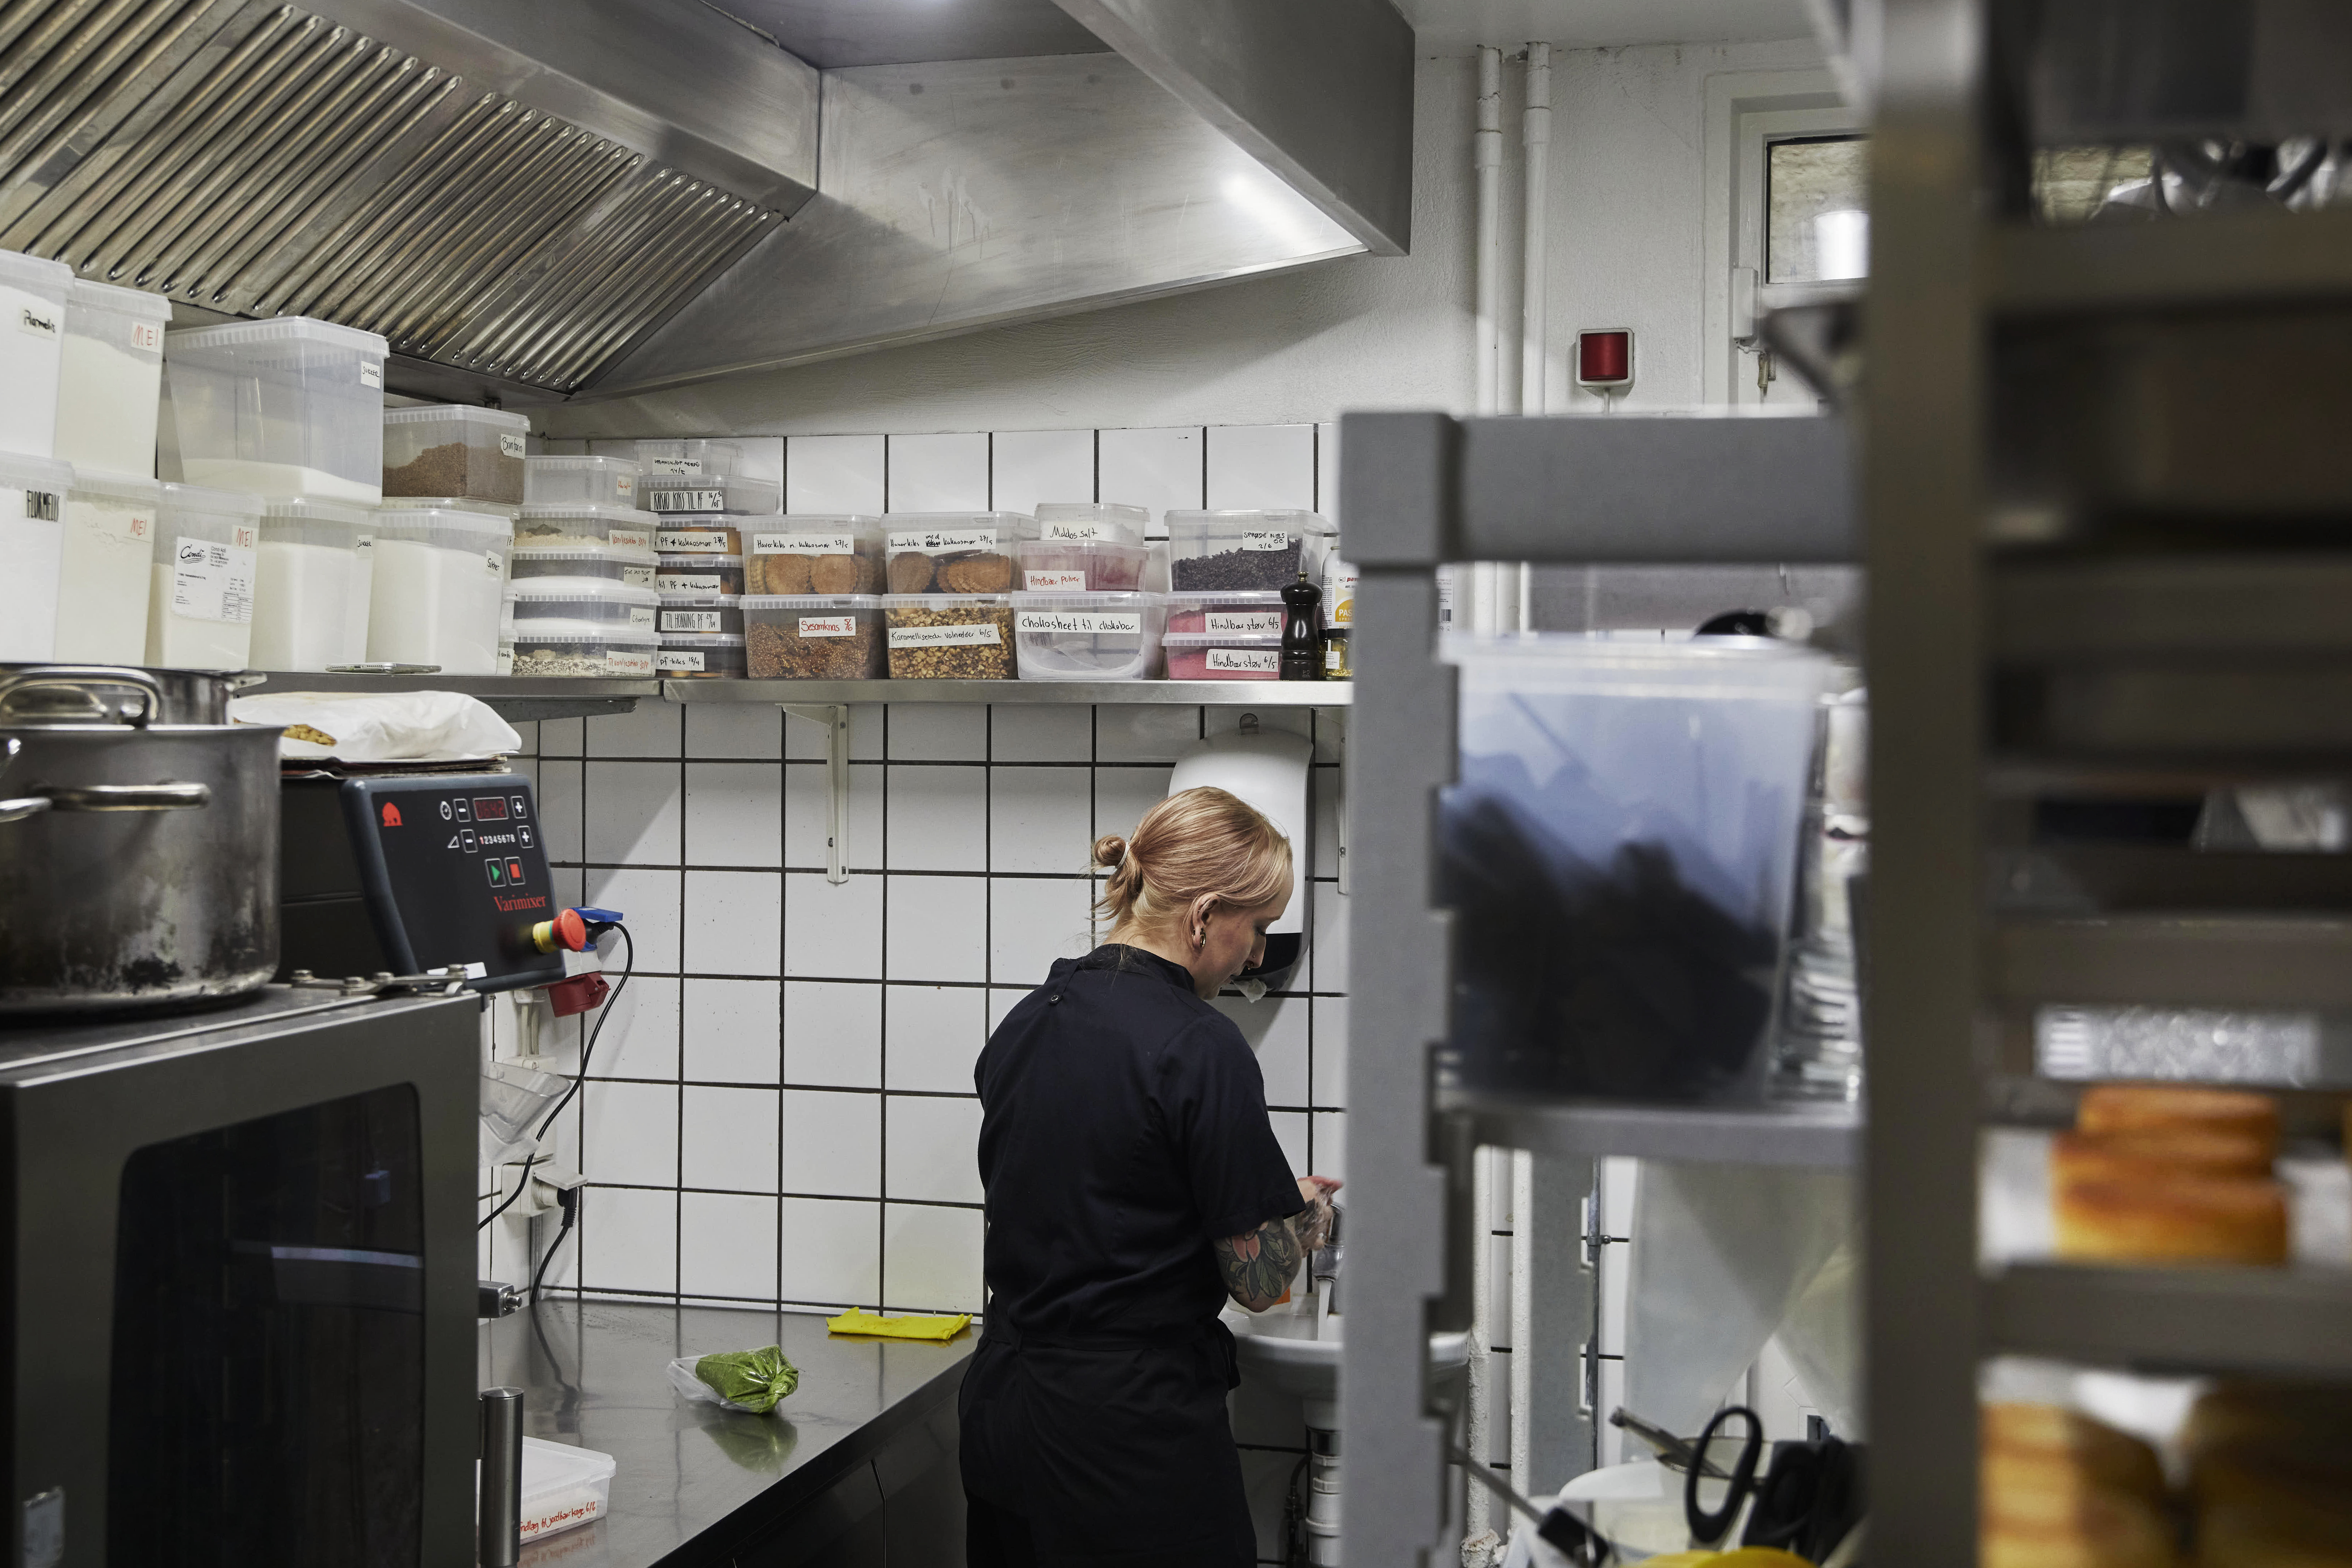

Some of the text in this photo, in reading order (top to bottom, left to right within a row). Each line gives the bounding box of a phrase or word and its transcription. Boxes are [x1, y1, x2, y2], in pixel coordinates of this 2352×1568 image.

[654, 492, 669, 510] KAKAO
[673, 492, 685, 511] KIKS
[686, 492, 696, 510] TIL
[698, 492, 704, 509] PF
[835, 539, 848, 548] 27/5
[979, 535, 993, 545] 27/5
[180, 544, 205, 559] Condi
[670, 581, 677, 589] PF
[675, 613, 695, 629] HONNING
[698, 614, 704, 629] PF
[801, 618, 853, 631] Sesamknas 5/6
[1082, 618, 1092, 631] til
[1268, 617, 1279, 629] 6/5
[689, 657, 700, 666] 18/4
[1264, 656, 1278, 669] 6/5
[494, 893, 546, 912] Varimixer
[586, 1501, 596, 1514] 6/6
